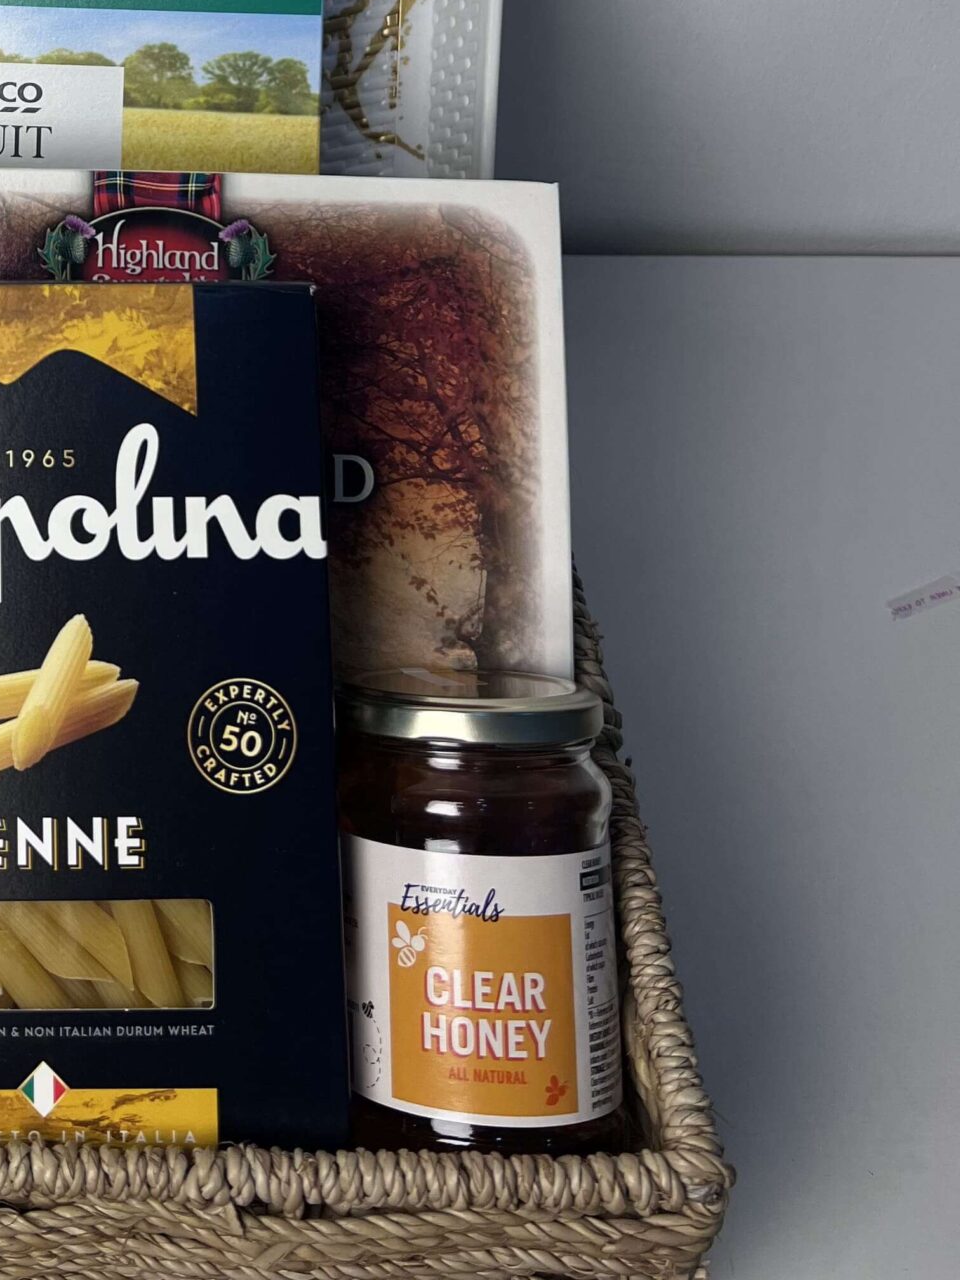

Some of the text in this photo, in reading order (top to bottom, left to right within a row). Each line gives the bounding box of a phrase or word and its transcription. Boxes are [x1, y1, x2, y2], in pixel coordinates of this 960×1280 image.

[94, 220, 219, 274] Highland
[5, 449, 77, 469] 1965
[204, 684, 291, 730] EXPERTLY
[220, 724, 262, 757] 50
[196, 745, 277, 787] CRAFTED
[400, 883, 505, 922] Essentials
[420, 885, 457, 895] EVERYDAY
[424, 966, 546, 1012] CLEAR
[11, 1026, 20, 1037] &
[25, 1026, 55, 1037] NON
[60, 1026, 112, 1037] ITALIAN
[117, 1025, 163, 1037] DURUM
[168, 1024, 215, 1036] WHEAT
[421, 1012, 552, 1061] HONEY
[448, 1066, 527, 1085] ALL NATURAL
[62, 1130, 85, 1143] IN
[107, 1130, 197, 1144] ITALIA
